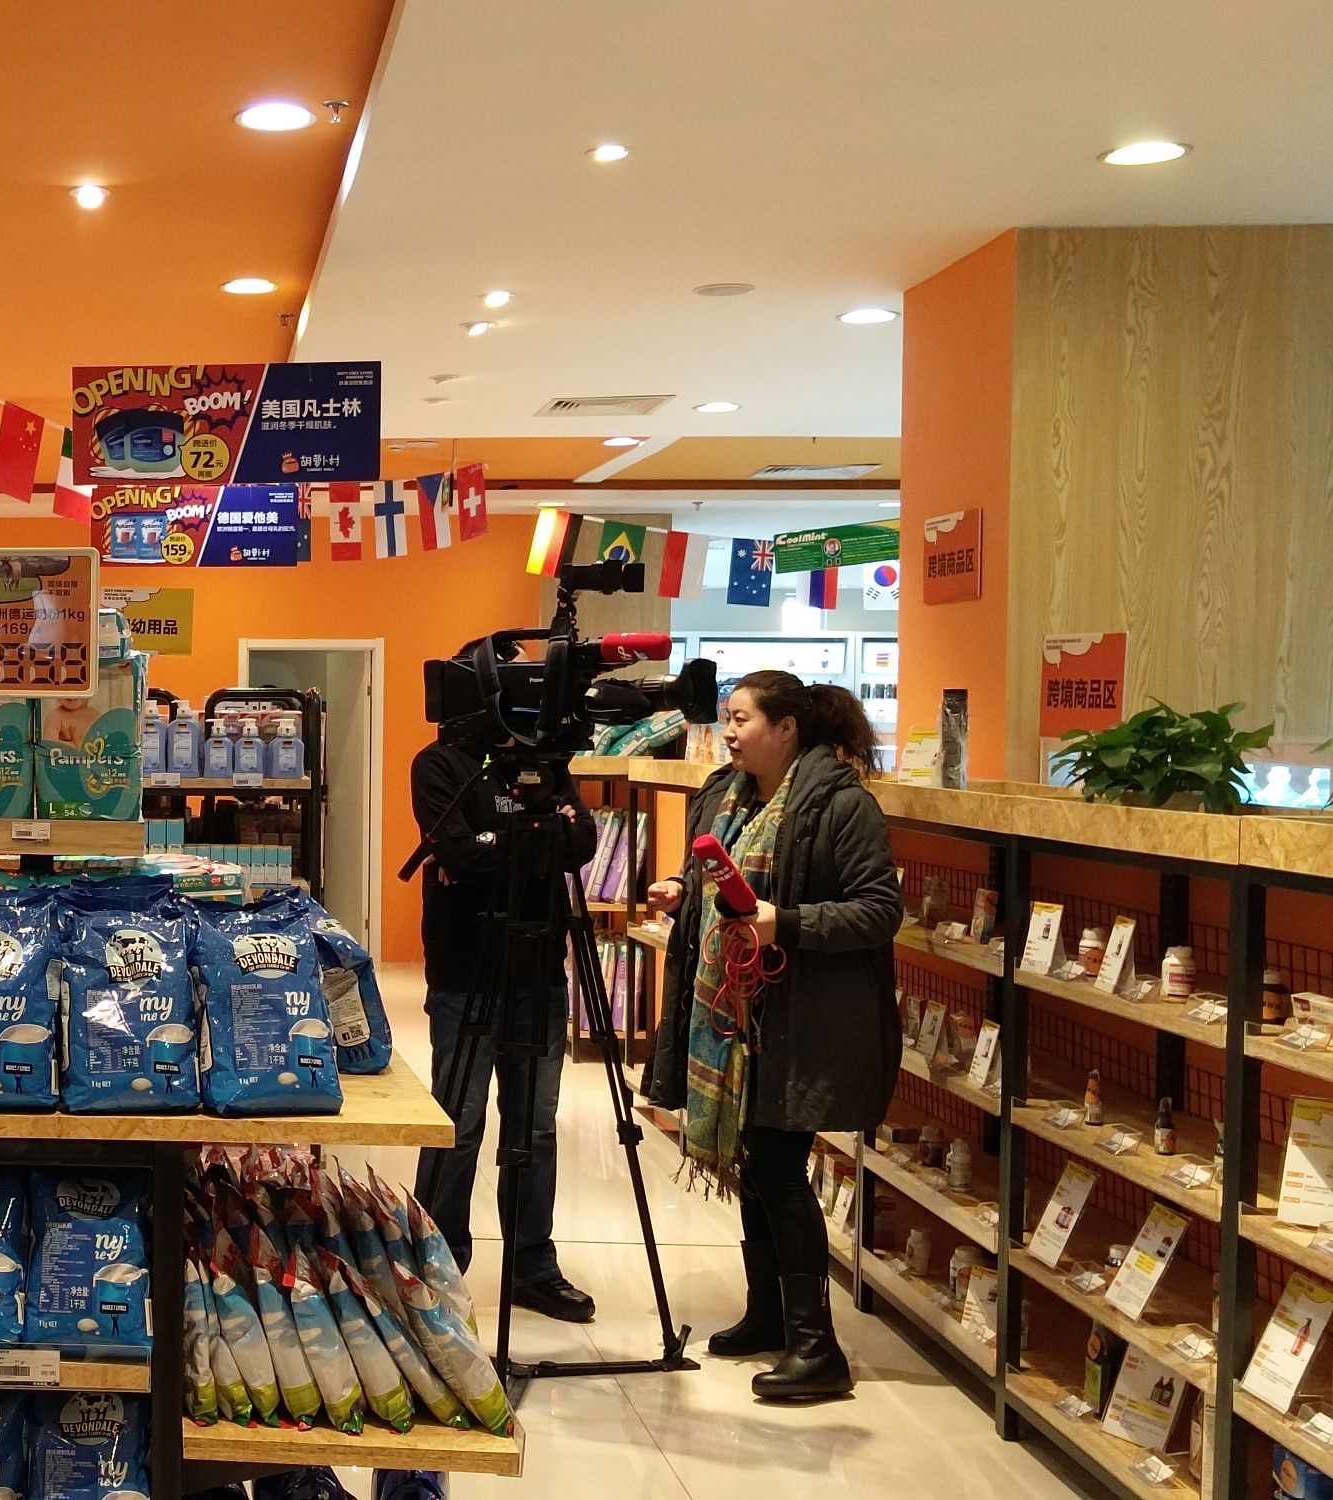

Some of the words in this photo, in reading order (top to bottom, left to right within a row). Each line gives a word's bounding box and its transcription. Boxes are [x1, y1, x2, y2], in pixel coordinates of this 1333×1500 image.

[73, 364, 206, 414] OPENING!
[184, 389, 252, 416] BOOM!
[261, 397, 362, 419] 美国凡士林
[91, 486, 181, 520] OPENING!
[166, 503, 213, 521] BOOM!
[217, 511, 278, 524] 德国爱他美
[927, 548, 975, 578] 跨境商品区
[127, 618, 178, 635] 幼用品
[1046, 678, 1118, 709] 跨境商品区
[48, 747, 125, 769] Pampers
[239, 952, 296, 969] DEVONDALE
[62, 1420, 120, 1435] DEVONDALE
